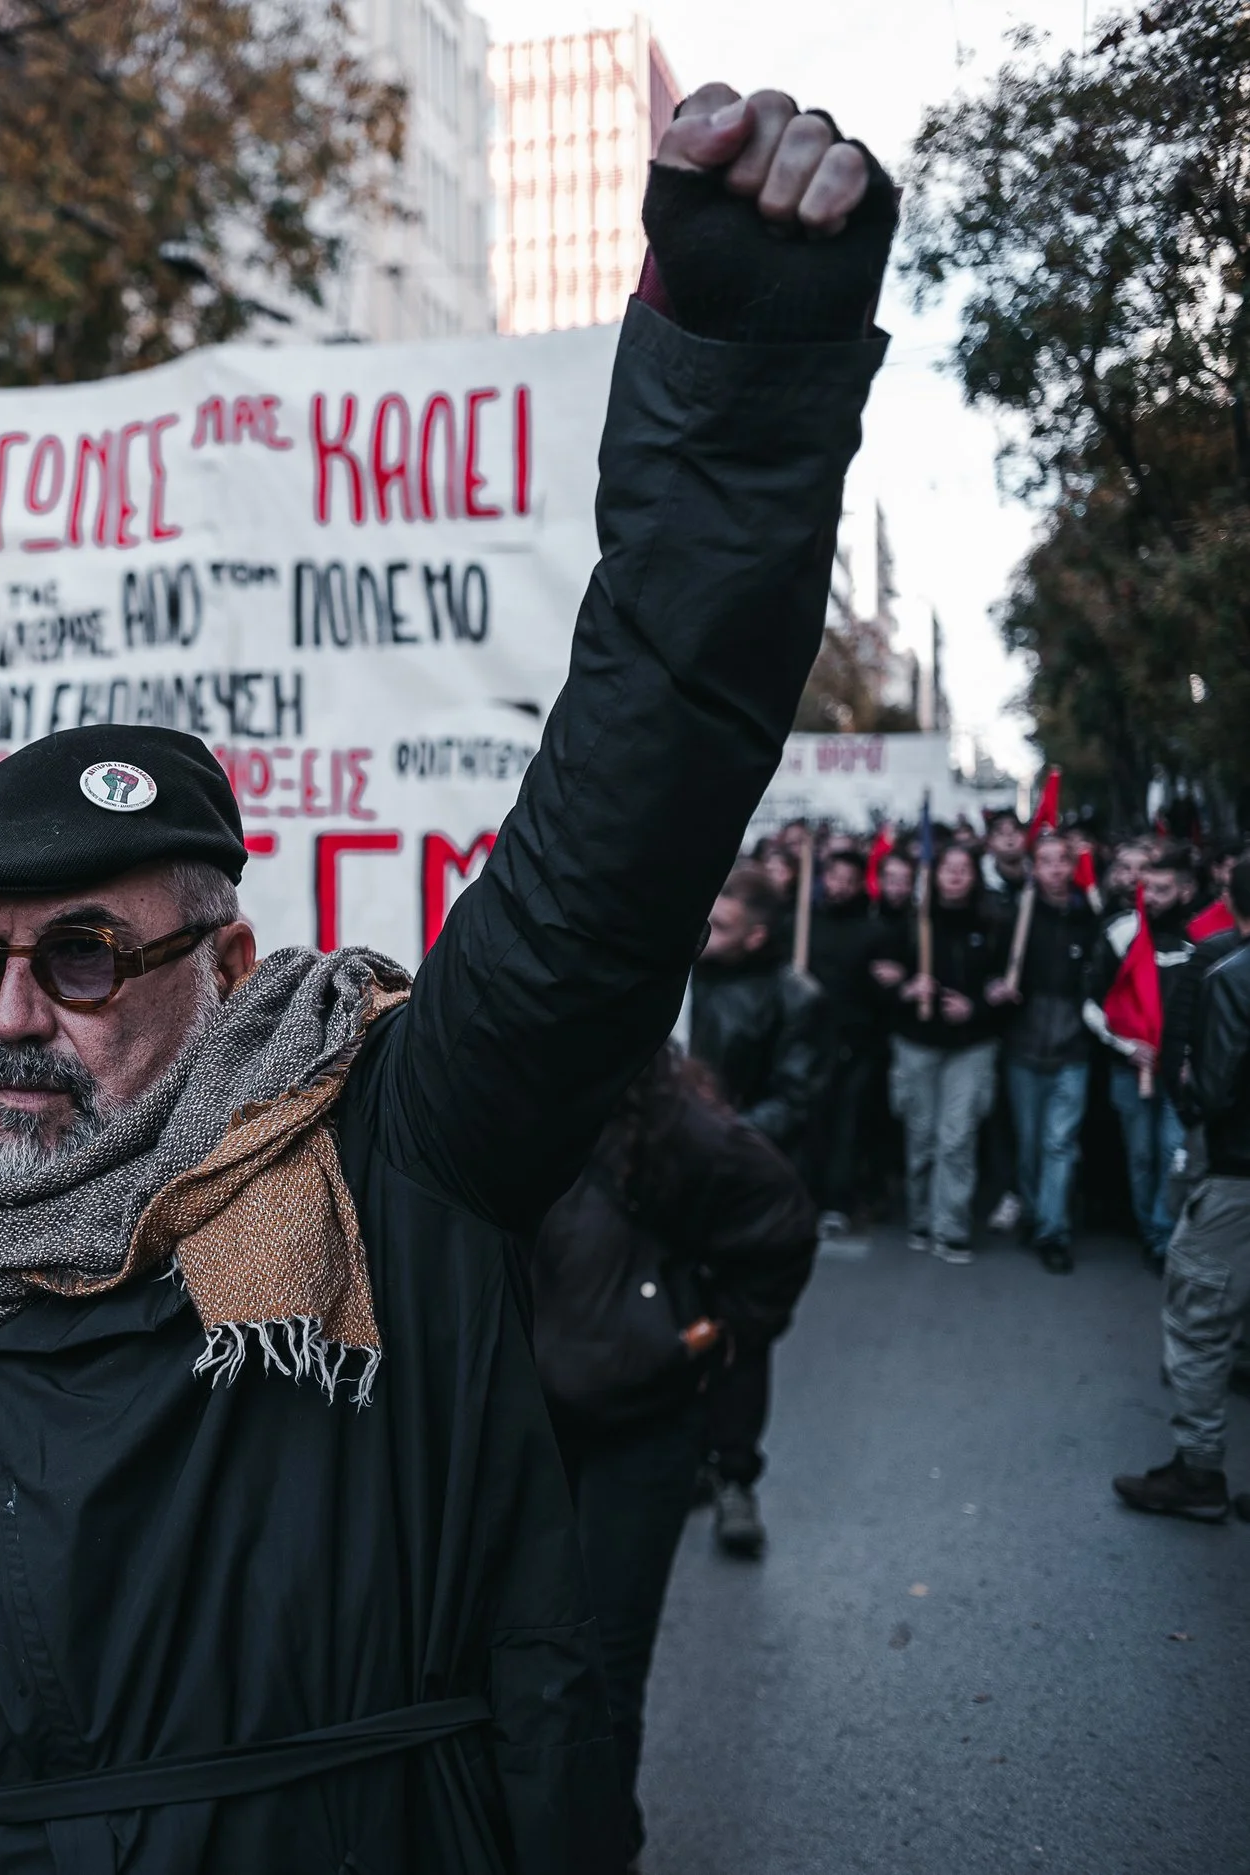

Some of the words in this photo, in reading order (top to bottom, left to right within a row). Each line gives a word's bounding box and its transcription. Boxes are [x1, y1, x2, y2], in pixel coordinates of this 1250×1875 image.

[192, 395, 293, 450] ΜΑΣ
[310, 383, 532, 527] ΚΑΛΕΙ
[121, 558, 204, 650] ΑΠΟ
[207, 560, 282, 590] ΤΟΝ
[290, 556, 494, 652] ΠΟΛΕΜΟ
